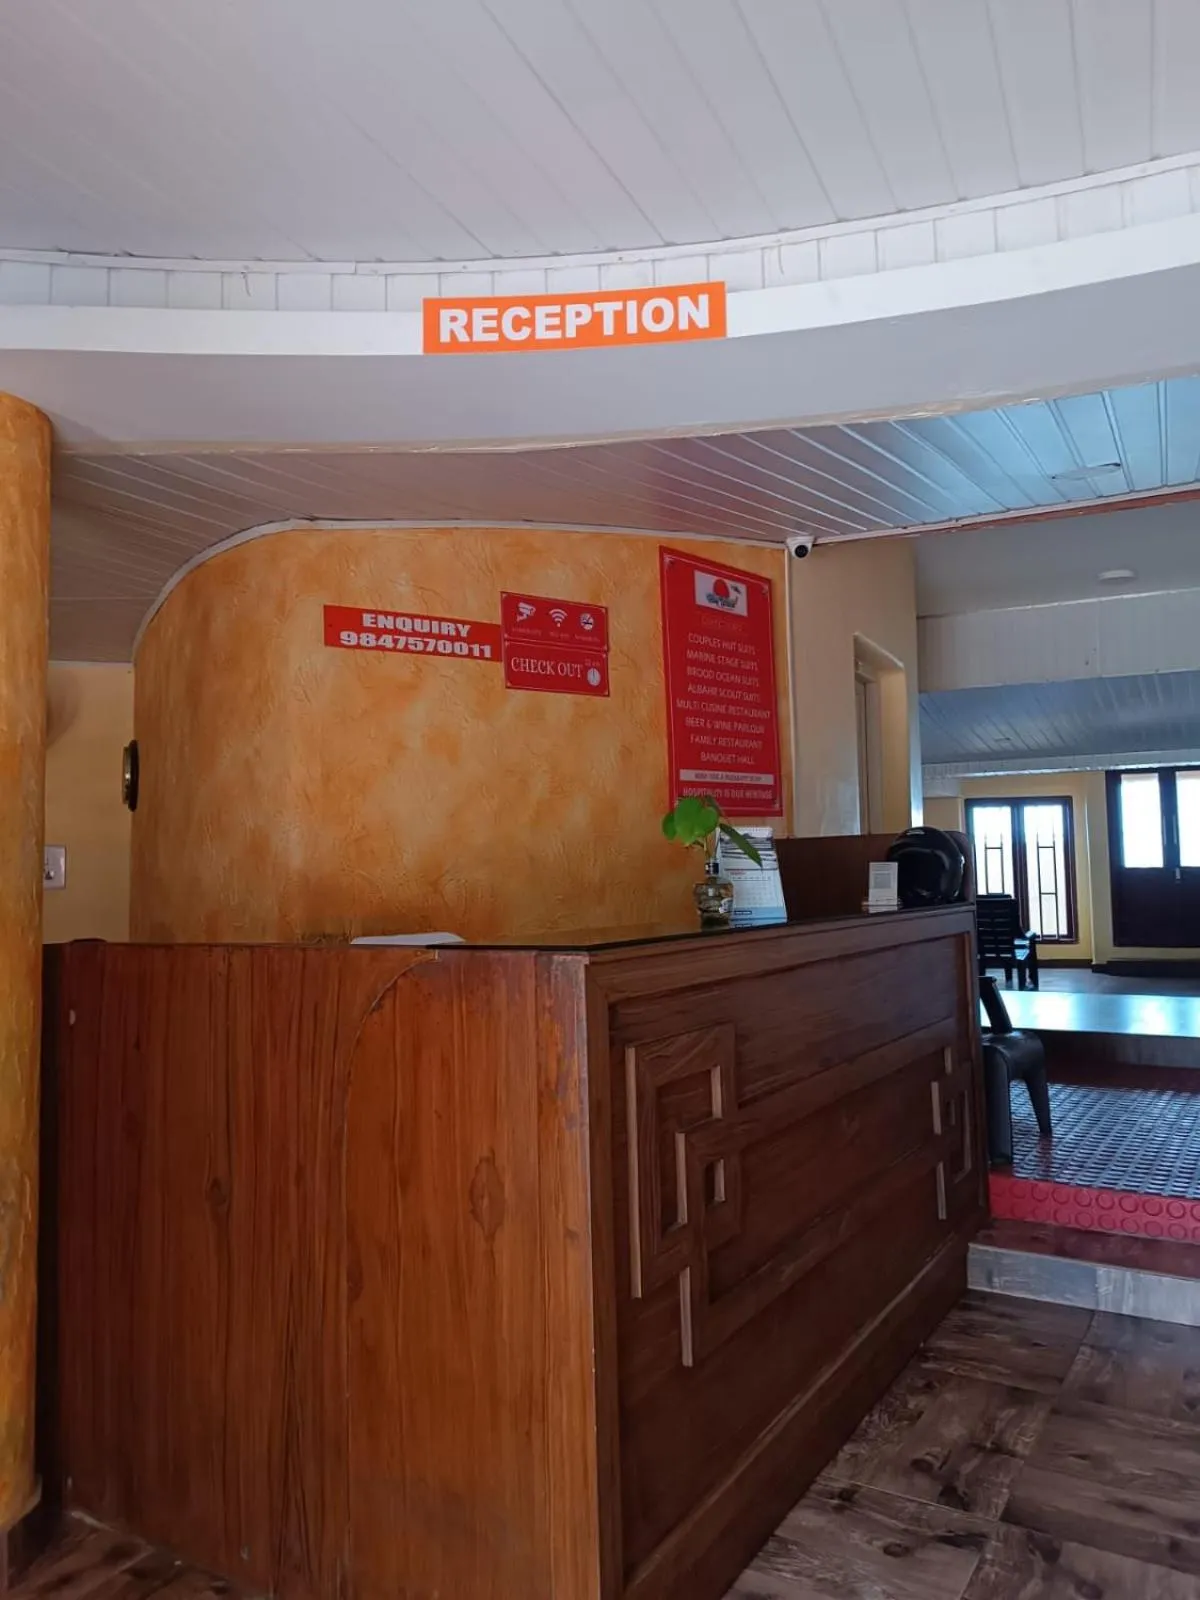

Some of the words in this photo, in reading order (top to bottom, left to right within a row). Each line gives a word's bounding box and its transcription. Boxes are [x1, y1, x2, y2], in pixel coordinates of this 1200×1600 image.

[439, 294, 710, 343] RECEPTION
[362, 613, 472, 638] ENQUIRY
[339, 631, 491, 658] 9847570011
[511, 657, 555, 676] CHECK
[557, 662, 583, 678] OUT
[728, 705, 771, 719] RESTAURANT
[690, 733, 717, 746] FAMILY
[718, 737, 763, 750] RESTAURANT
[700, 751, 736, 764] BANQUET
[737, 754, 756, 765] HALL
